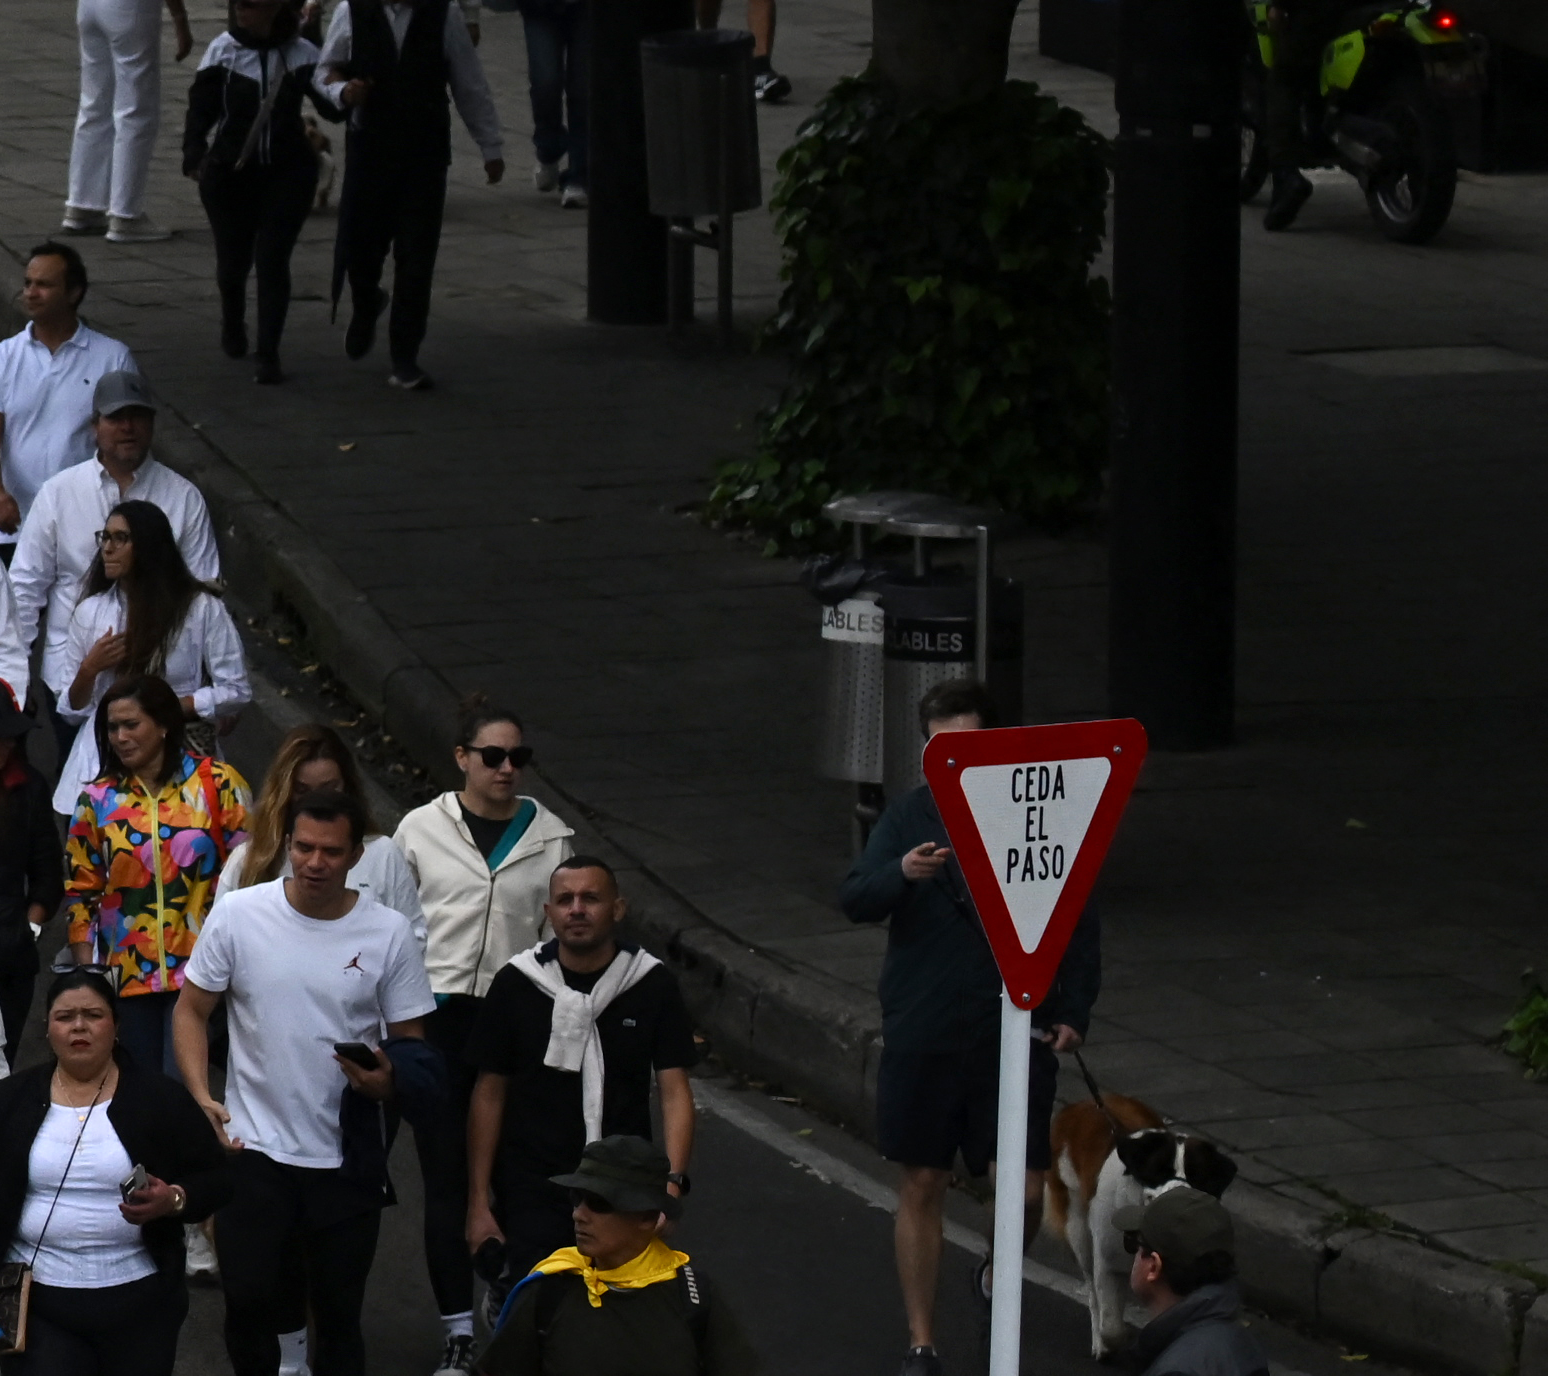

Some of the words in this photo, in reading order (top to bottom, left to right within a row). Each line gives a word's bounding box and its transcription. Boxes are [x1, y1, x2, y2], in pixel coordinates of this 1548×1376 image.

[1011, 764, 1066, 803] CEDA
[1025, 806, 1049, 842] EL
[1006, 844, 1065, 884] PASO
